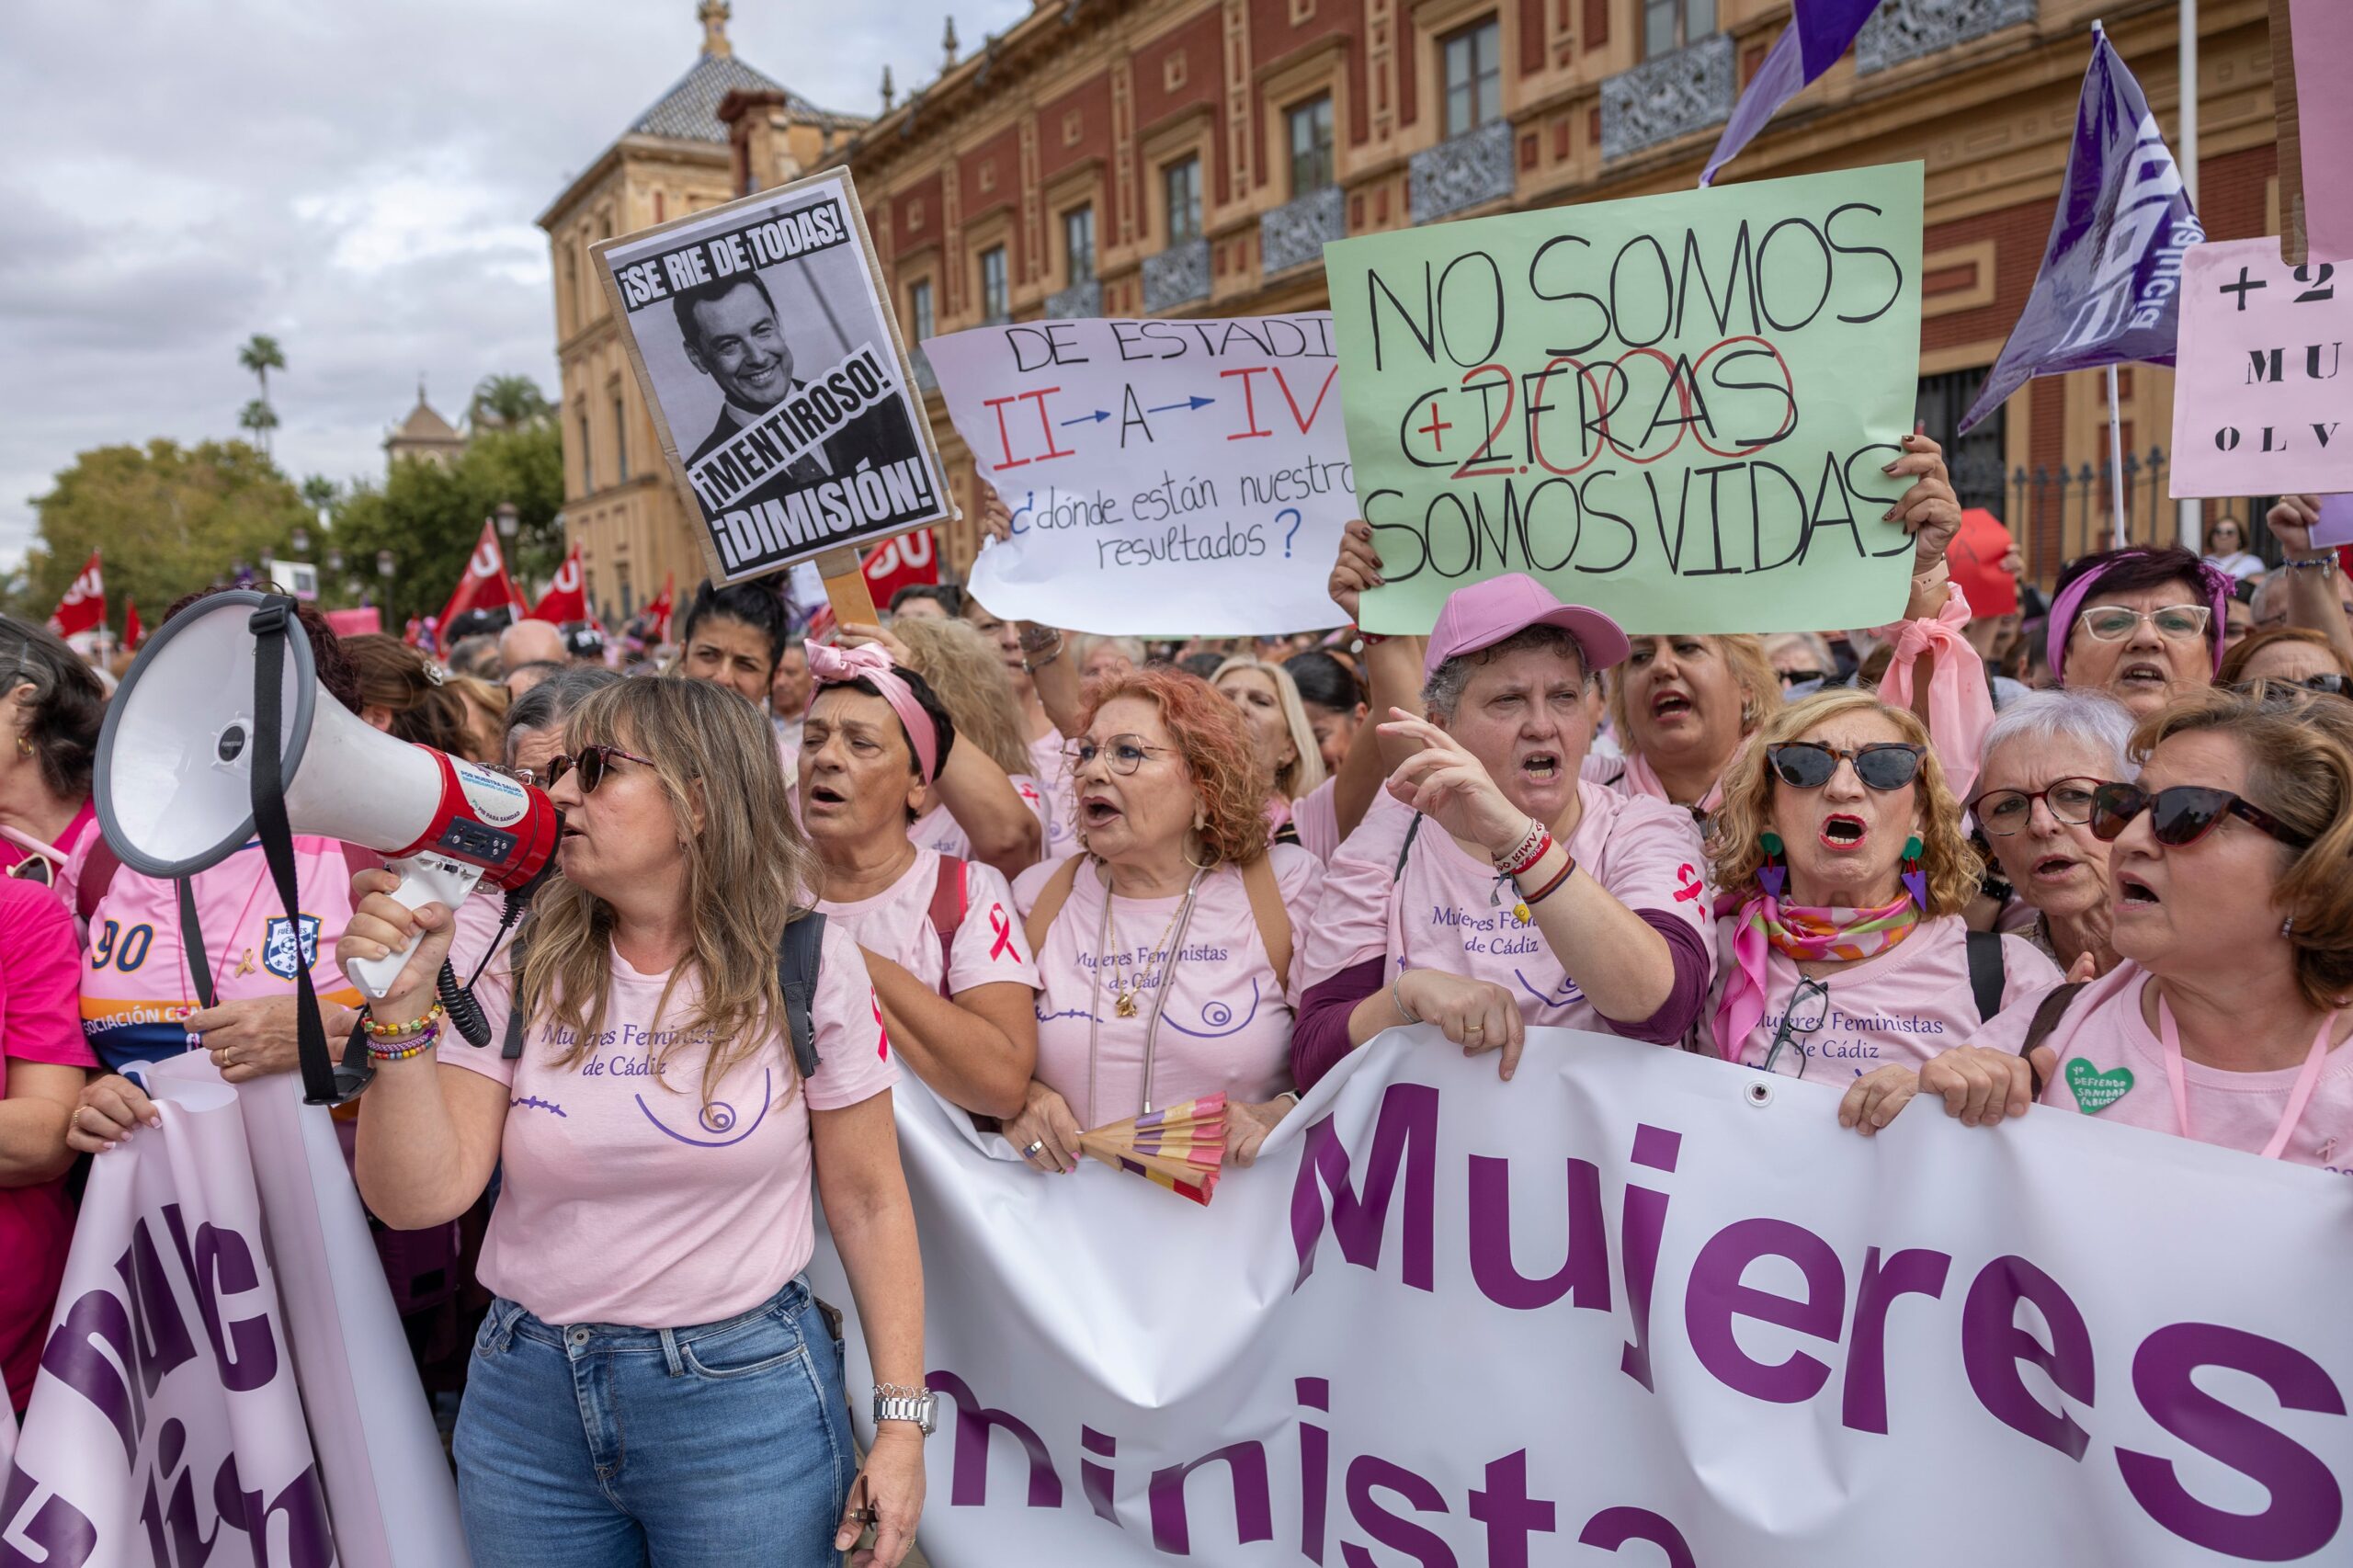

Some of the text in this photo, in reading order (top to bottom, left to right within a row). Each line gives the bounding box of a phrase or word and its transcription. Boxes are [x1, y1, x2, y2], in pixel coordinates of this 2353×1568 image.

[620, 203, 847, 307] ¡SE RIE DE TODAS!
[1368, 250, 1505, 371] NO
[1529, 202, 1903, 357] SOMOS
[1006, 324, 1089, 372] DE
[693, 350, 892, 513] ¡MENTIROSO!
[983, 386, 1076, 471] II
[1120, 383, 1154, 449] A
[1220, 364, 1339, 441] IV
[1401, 347, 1799, 469] CIFRAS
[711, 457, 933, 570] ¡DIMISIÓN!
[1131, 470, 1219, 522] están
[1363, 441, 1918, 583] SOMOS VIDAS
[92, 919, 154, 972] 90
[1464, 935, 1540, 955] de Cádiz
[1822, 1038, 1881, 1059] Cádiz
[1831, 1012, 1944, 1034] Feministas
[582, 1054, 667, 1076] de Cádiz
[1291, 1081, 2347, 1562] Mujeres
